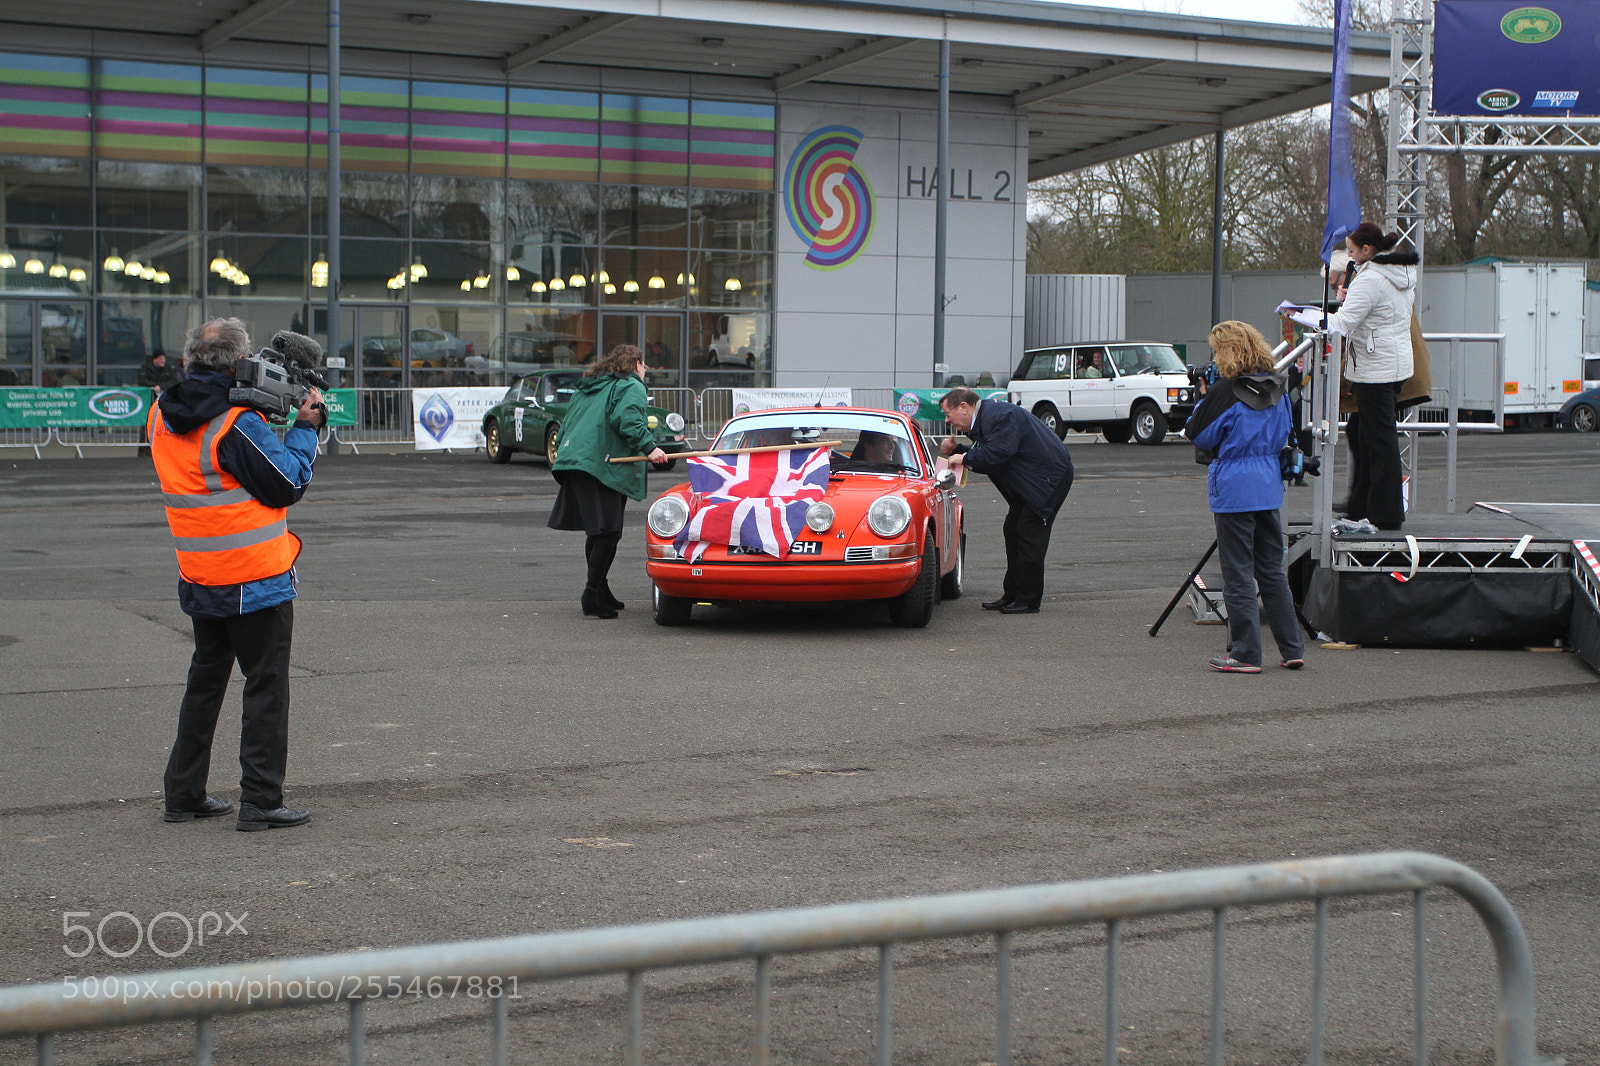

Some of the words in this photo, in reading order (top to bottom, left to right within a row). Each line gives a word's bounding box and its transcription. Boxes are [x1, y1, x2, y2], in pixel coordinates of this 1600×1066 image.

[1536, 91, 1578, 100] MOTORS
[993, 169, 1011, 202] 2
[1054, 354, 1067, 372] 19
[8, 391, 35, 400] Classic
[49, 391, 64, 399] hire
[64, 391, 75, 399] for
[735, 391, 770, 400] HISTORIC
[770, 391, 813, 399] ENDURANCE
[815, 391, 849, 399] RALLYING
[34, 401, 68, 409] corporate
[22, 409, 47, 417] private
[48, 409, 62, 417] use
[515, 419, 523, 442] 18
